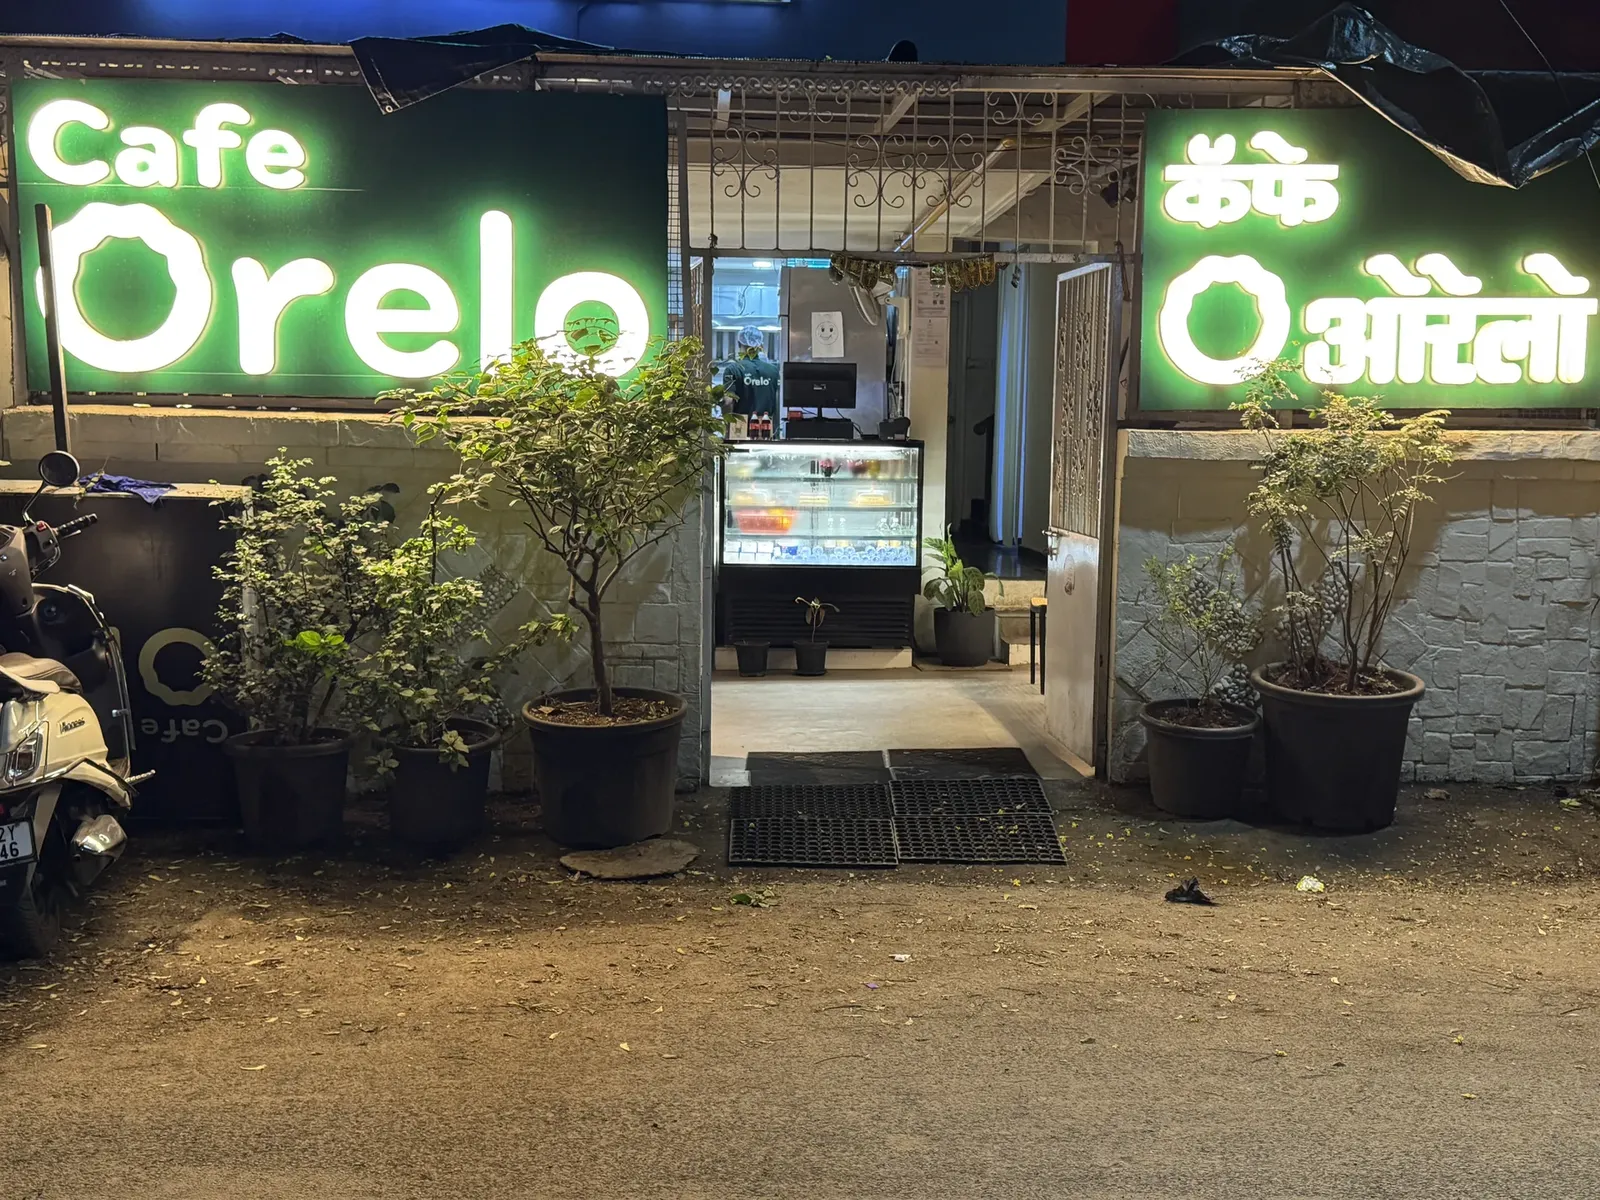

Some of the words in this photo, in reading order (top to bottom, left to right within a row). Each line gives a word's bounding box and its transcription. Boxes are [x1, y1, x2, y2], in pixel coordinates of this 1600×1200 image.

[27, 99, 307, 190] Cafe
[35, 202, 650, 379] Orelo
[1303, 252, 1598, 384] ओरेलो
[141, 718, 229, 743] Cafe
